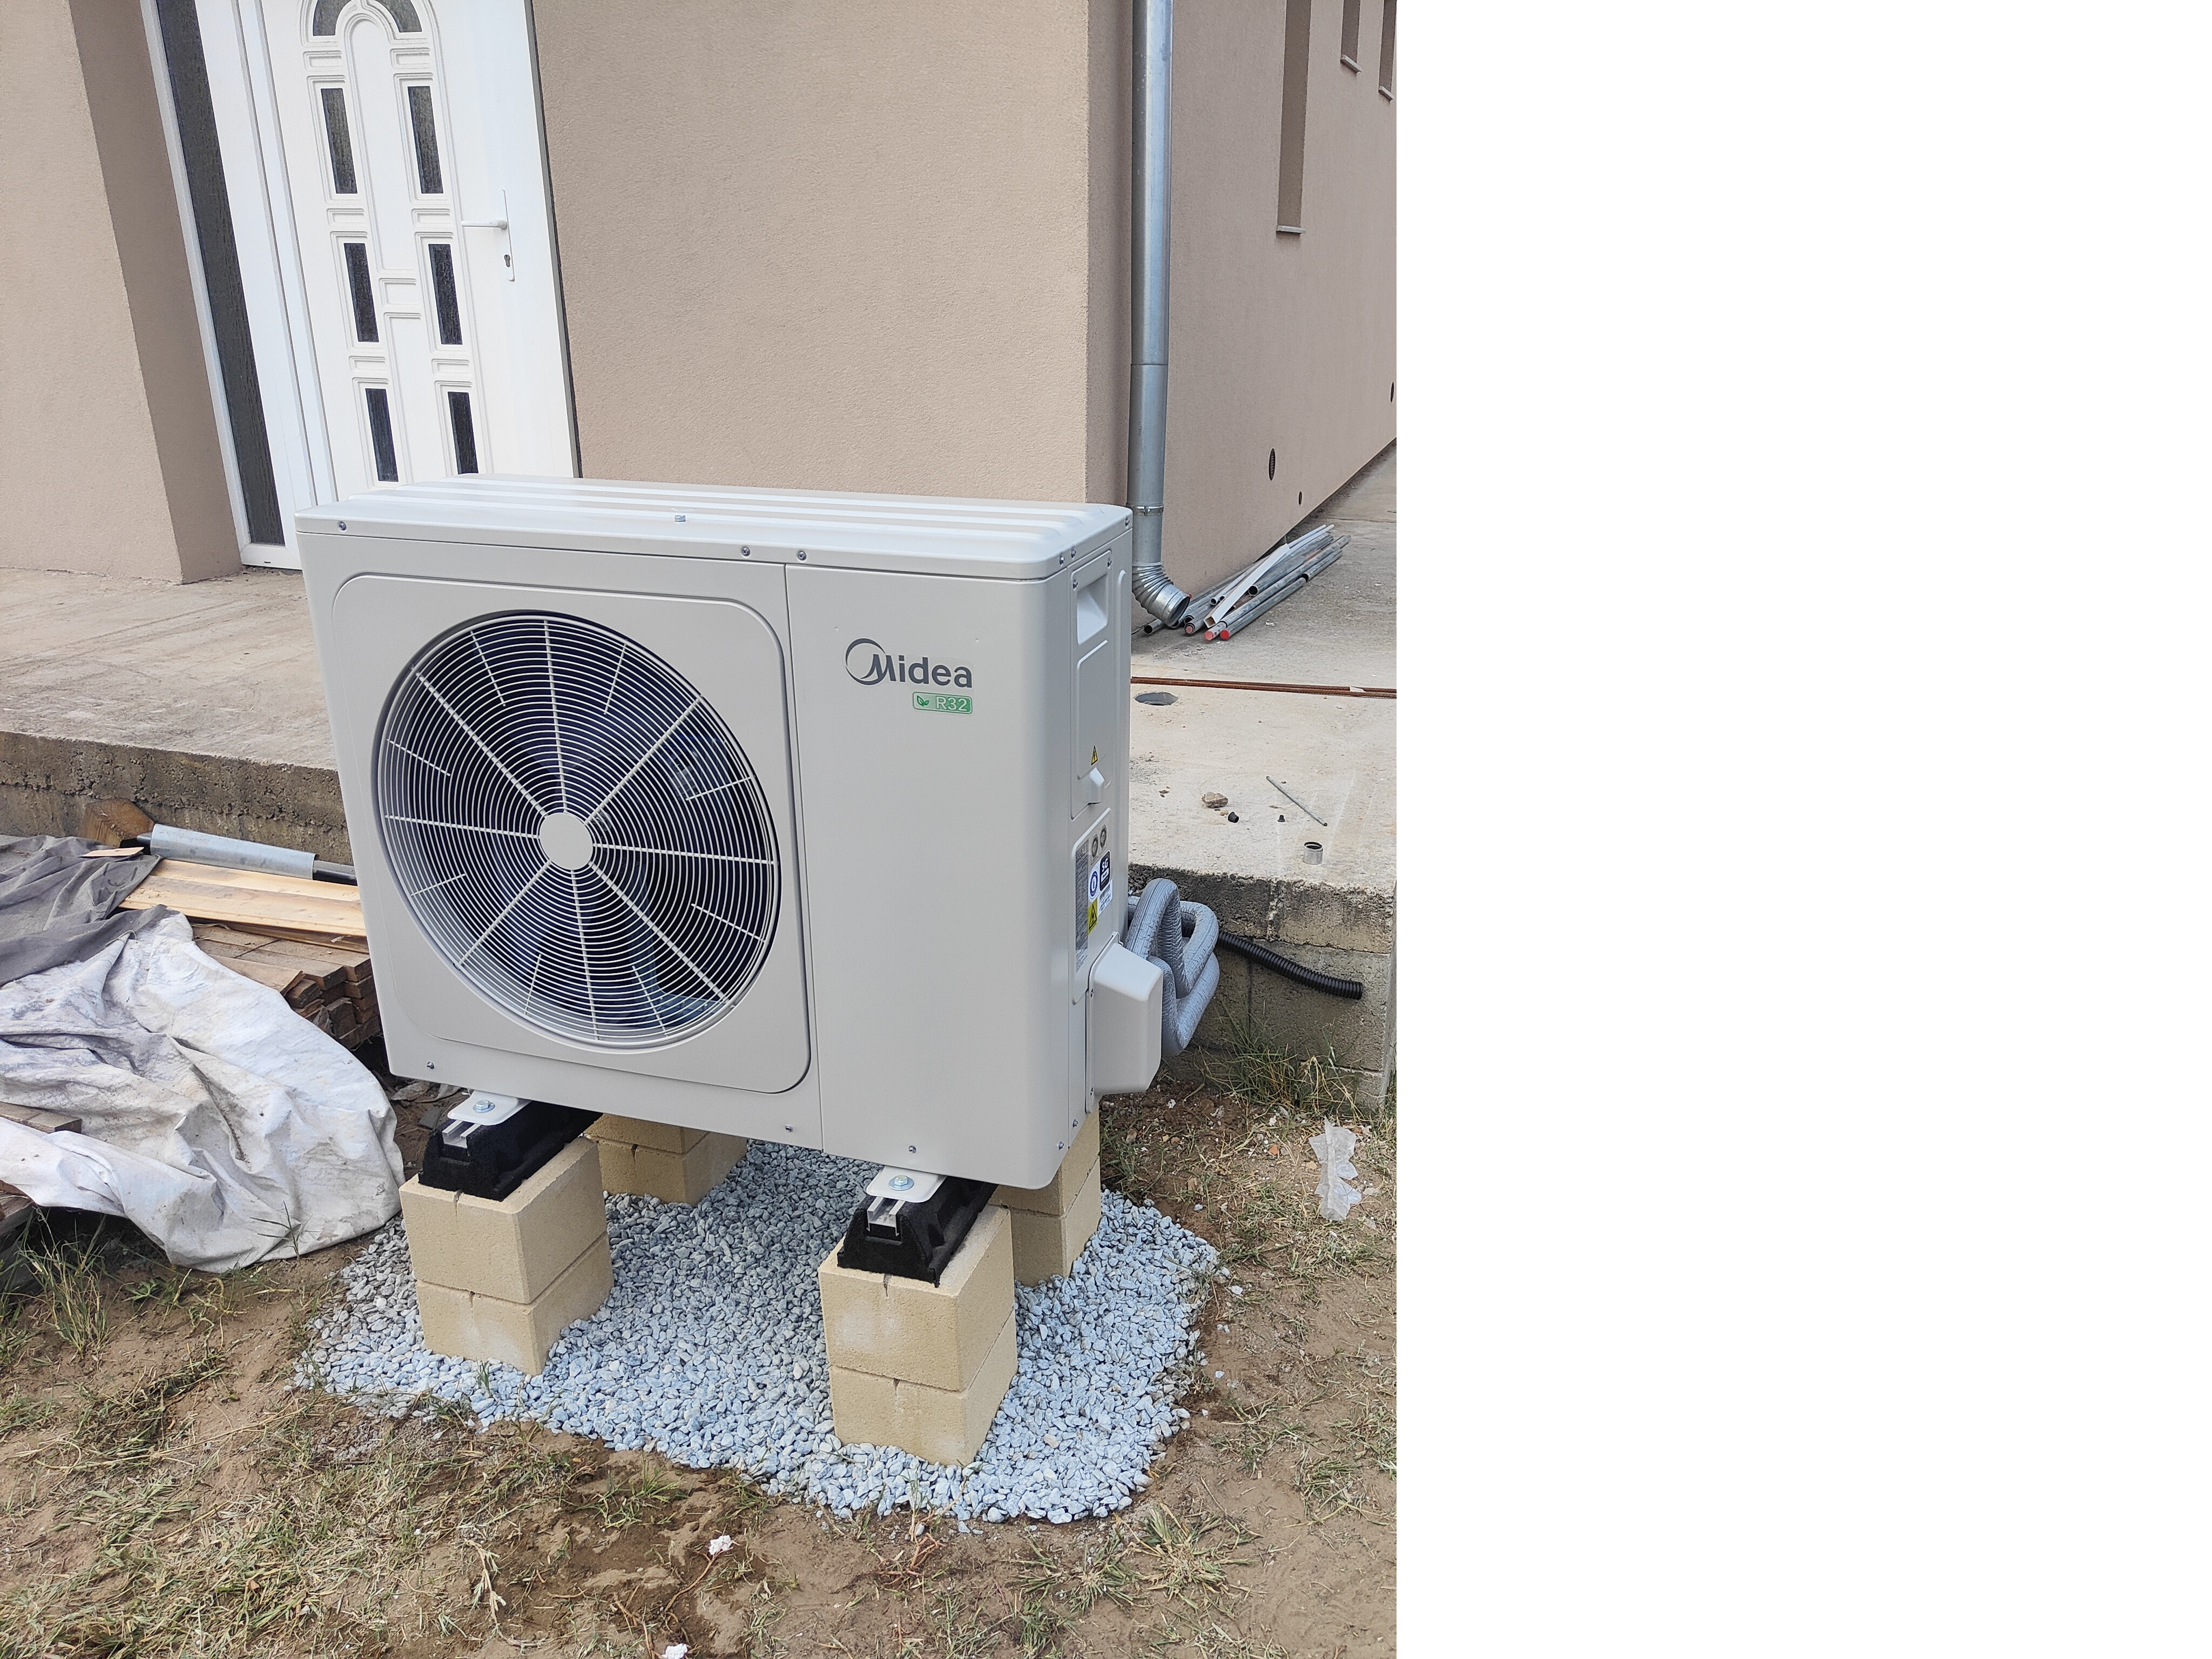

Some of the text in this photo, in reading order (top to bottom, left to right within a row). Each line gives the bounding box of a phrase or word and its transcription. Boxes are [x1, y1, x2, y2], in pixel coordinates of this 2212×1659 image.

[845, 638, 972, 688] Midea
[935, 696, 968, 712] R32
[1102, 858, 1108, 873] SG
